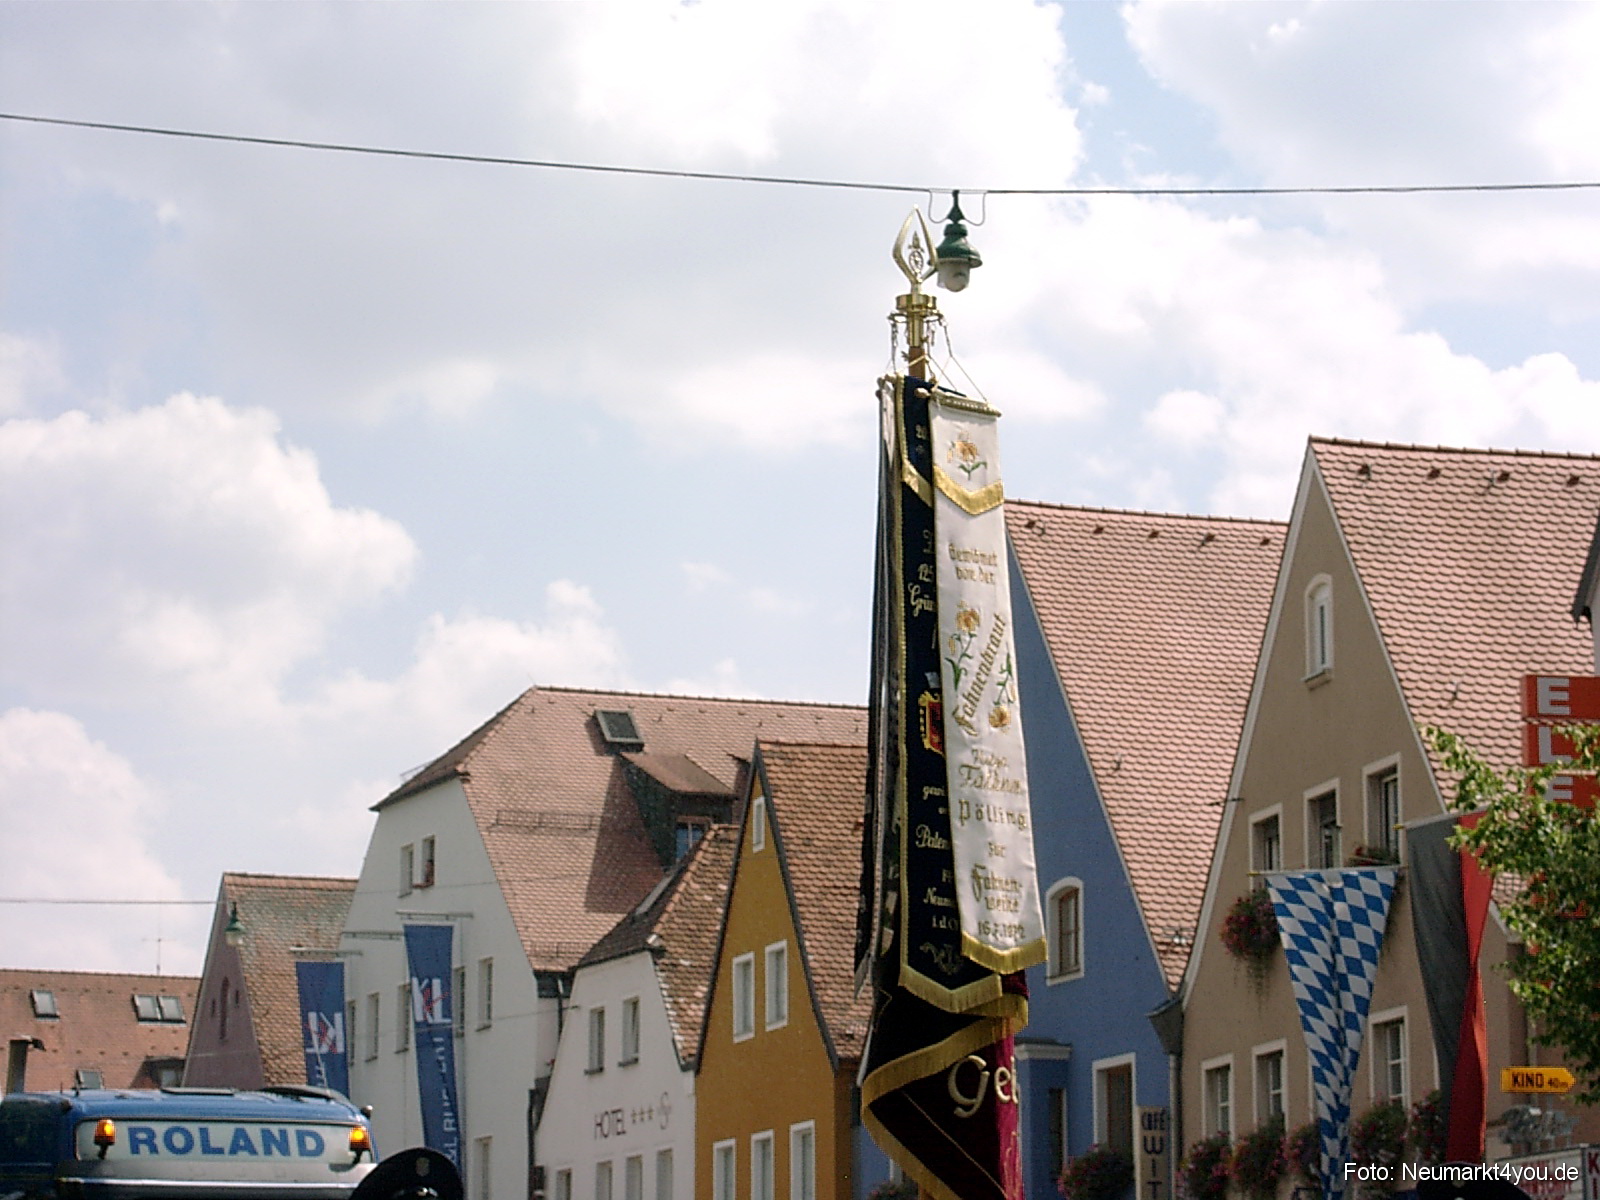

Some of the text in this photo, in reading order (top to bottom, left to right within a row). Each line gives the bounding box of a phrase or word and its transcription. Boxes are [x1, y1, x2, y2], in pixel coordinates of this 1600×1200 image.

[958, 798, 1027, 832] Pölling
[1511, 1072, 1544, 1088] KINO
[594, 1108, 627, 1140] HOTEL
[127, 1126, 326, 1158] ROLAND
